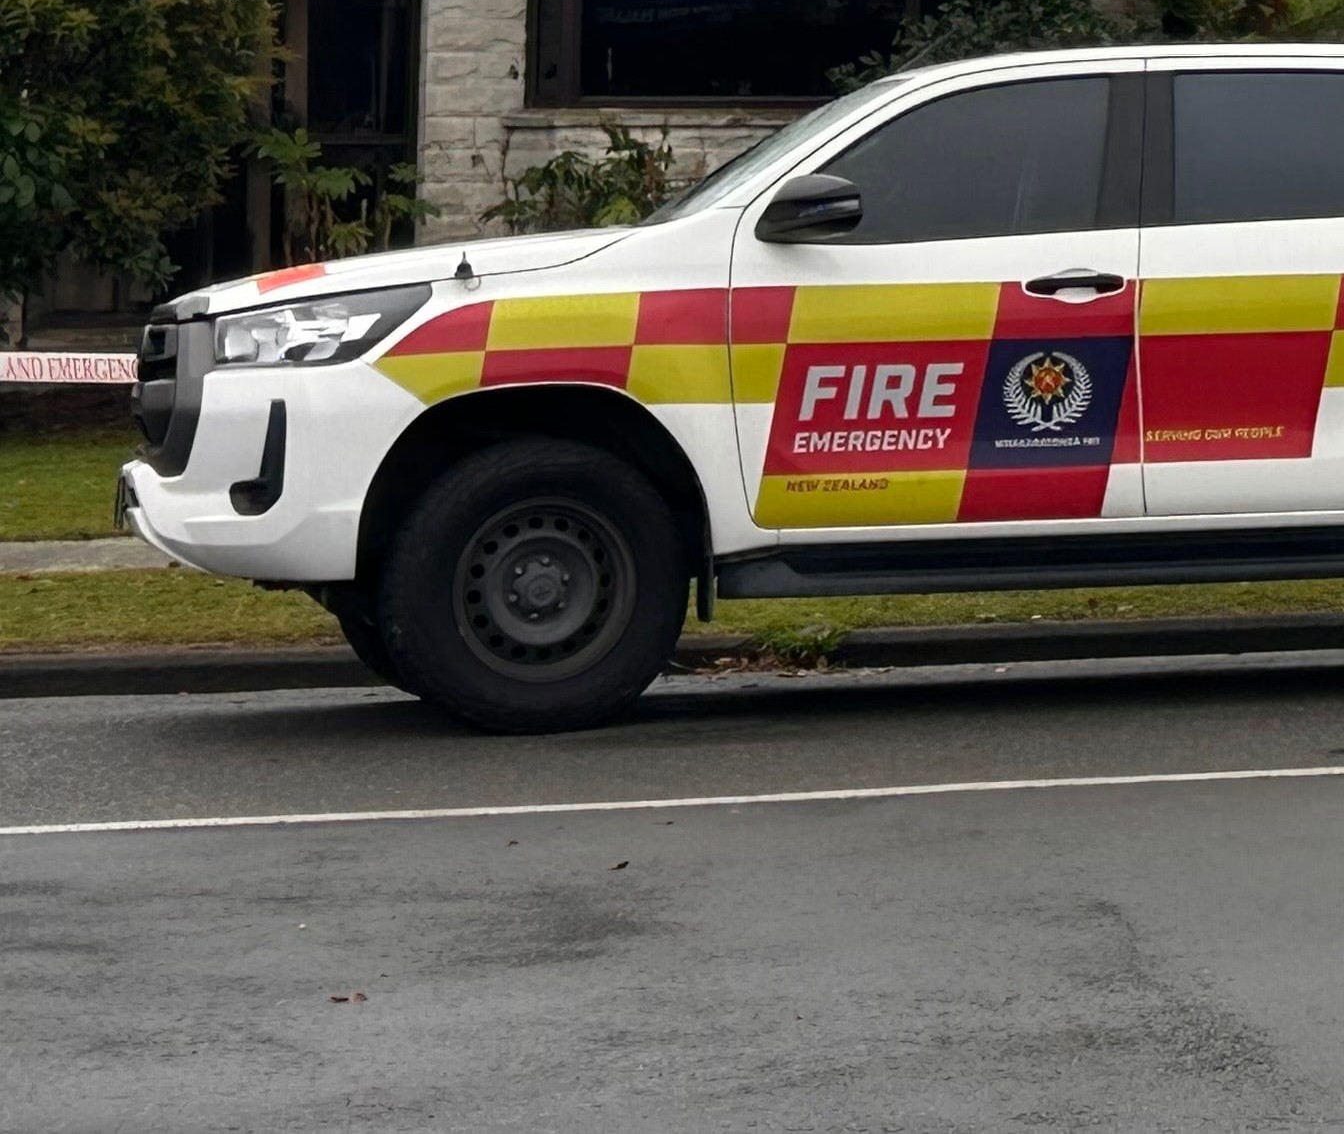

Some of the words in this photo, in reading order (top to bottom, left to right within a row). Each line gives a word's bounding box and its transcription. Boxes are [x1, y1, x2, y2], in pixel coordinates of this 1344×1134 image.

[7, 357, 44, 379] AND
[798, 363, 965, 421] FIRE
[793, 428, 952, 453] EMERGENCY
